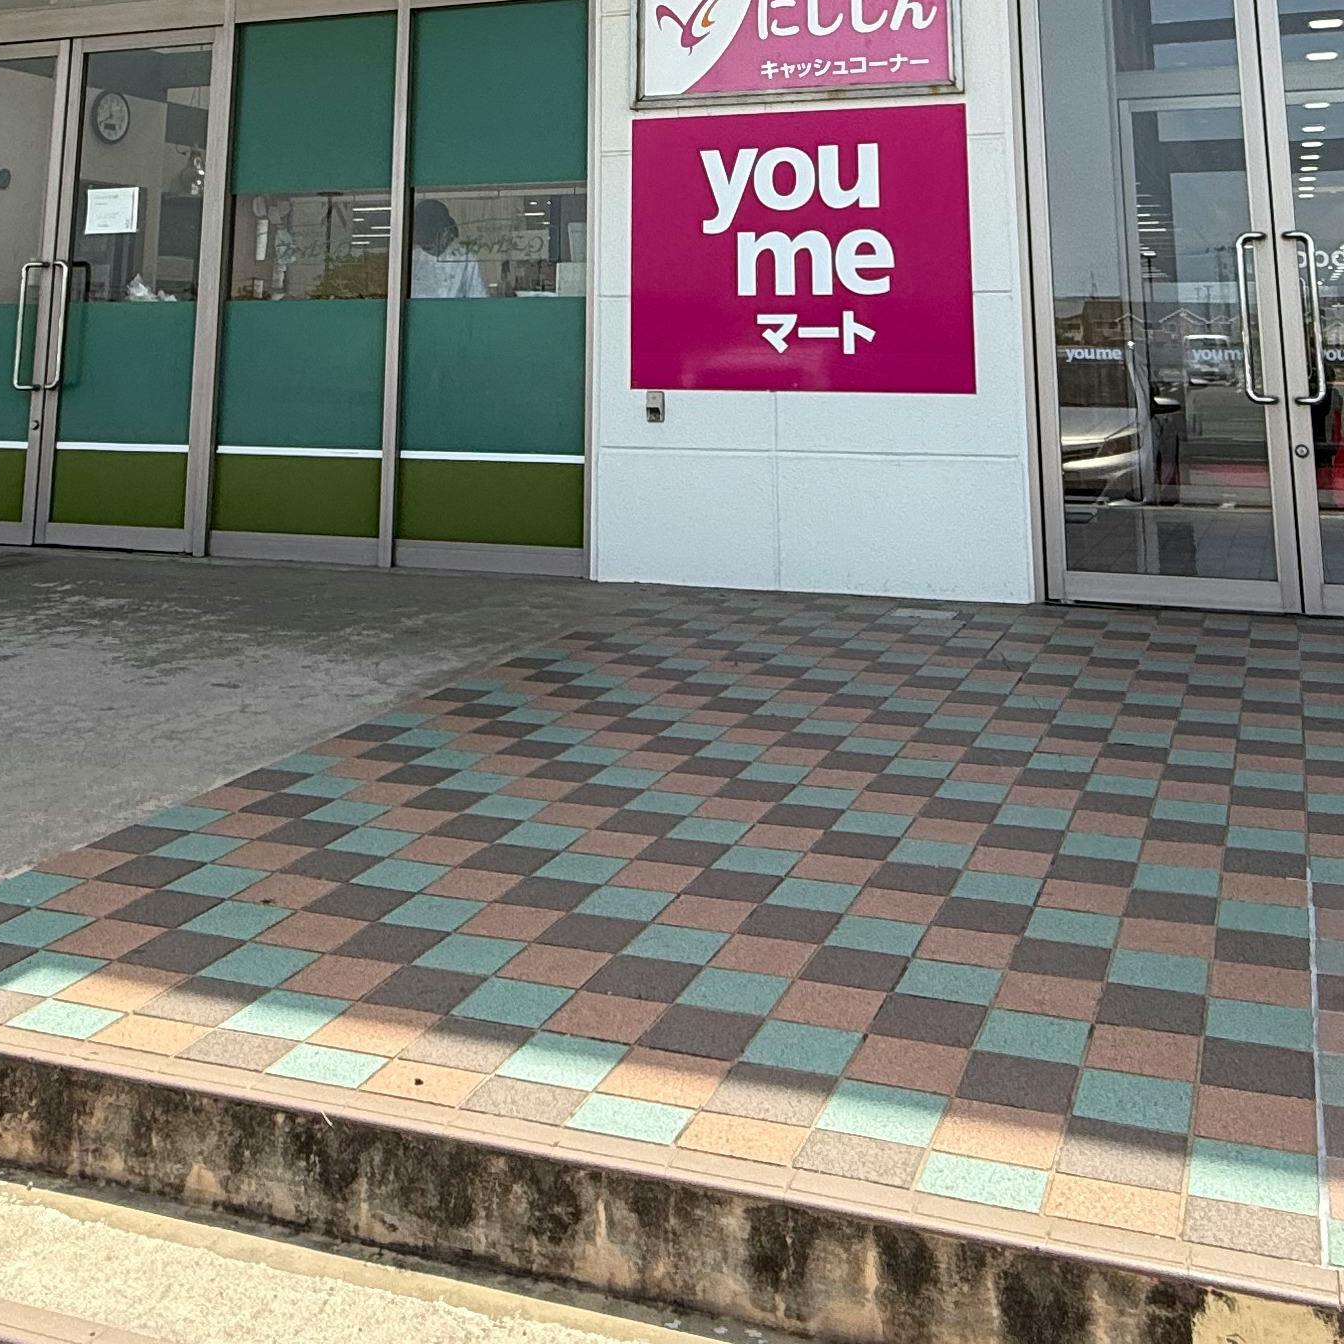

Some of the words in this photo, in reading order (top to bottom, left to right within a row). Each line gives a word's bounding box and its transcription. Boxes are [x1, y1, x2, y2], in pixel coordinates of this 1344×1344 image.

[760, 53, 930, 80] キャッシュコーナー
[700, 143, 880, 234] you
[736, 228, 895, 297] me
[757, 310, 876, 355] マート
[1066, 347, 1122, 362] youme
